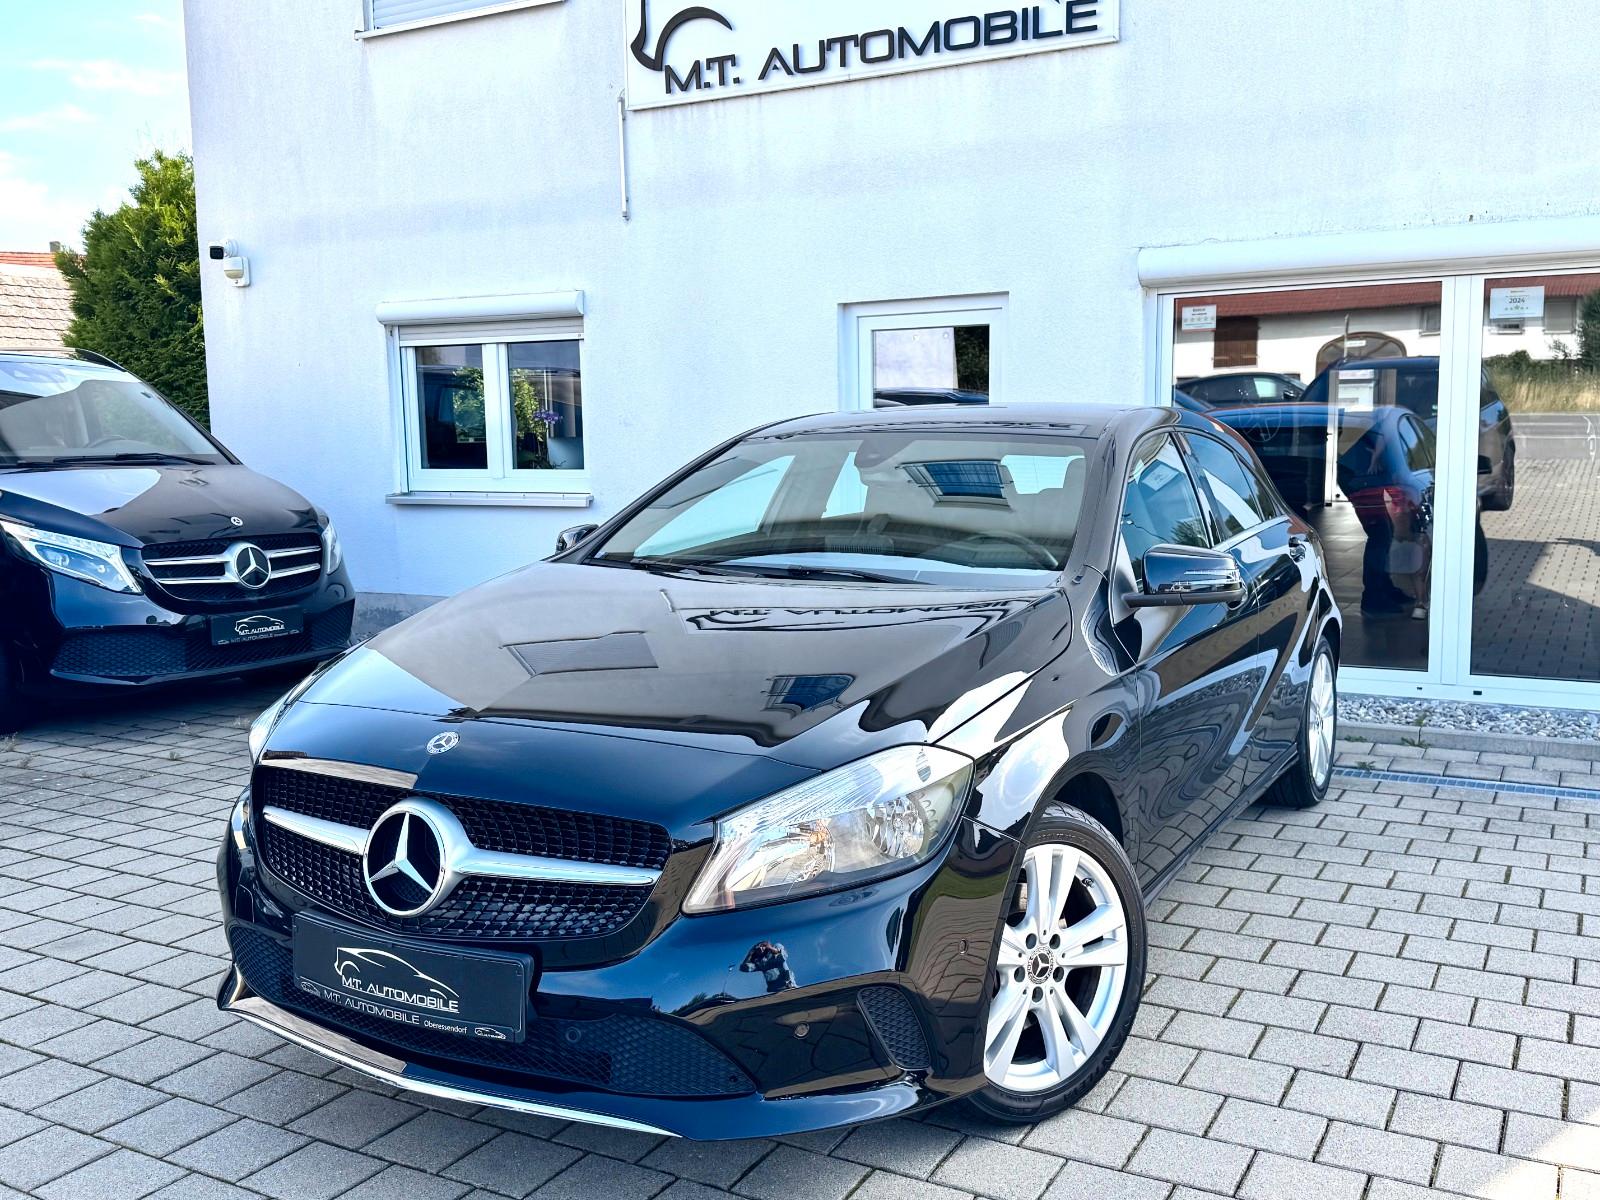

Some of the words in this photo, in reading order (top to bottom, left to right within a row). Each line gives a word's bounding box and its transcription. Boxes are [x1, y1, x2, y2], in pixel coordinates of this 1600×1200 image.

[664, 54, 740, 94] M.T.
[758, 0, 1098, 80] AUTOMOBILE
[323, 989, 342, 1004] M.T.
[344, 999, 420, 1025] AUTOMOBILE
[423, 1019, 468, 1034] Oberessendorf
[341, 974, 363, 991] M.T.
[366, 983, 460, 1012] AUTOMOBILE
